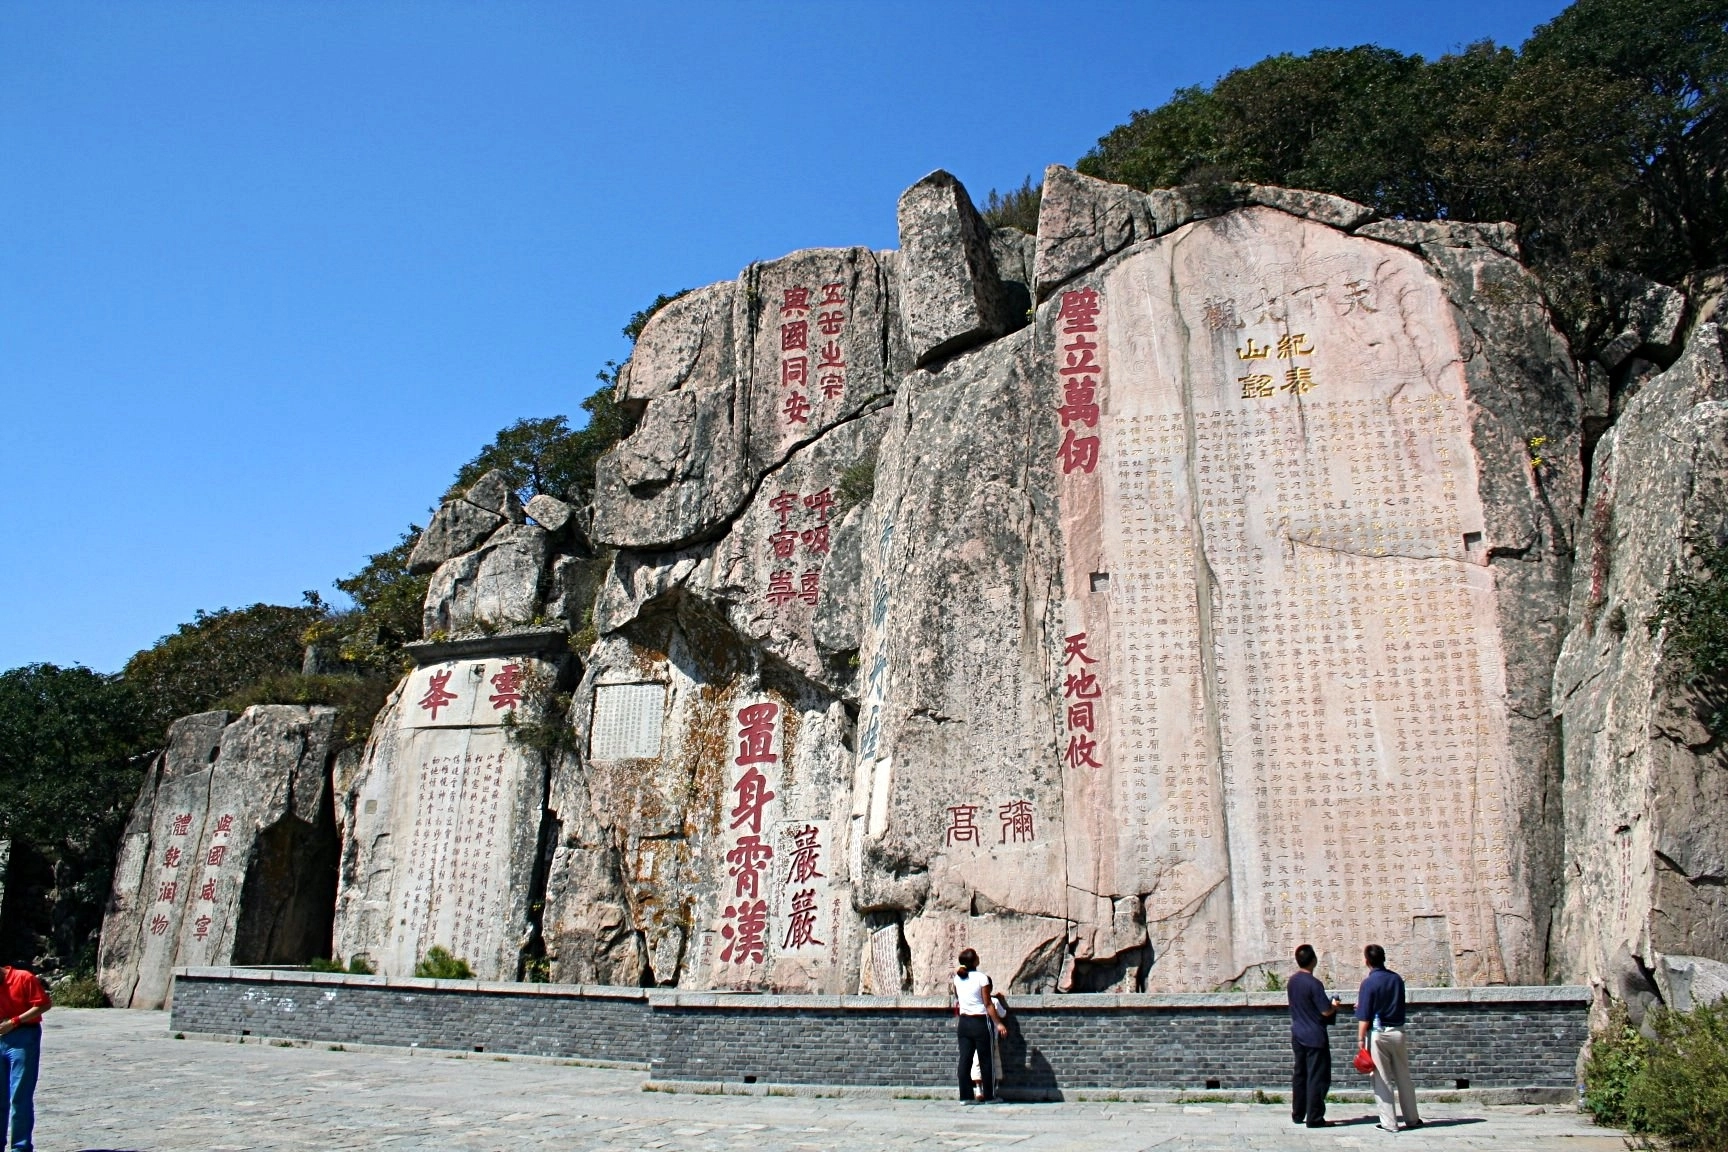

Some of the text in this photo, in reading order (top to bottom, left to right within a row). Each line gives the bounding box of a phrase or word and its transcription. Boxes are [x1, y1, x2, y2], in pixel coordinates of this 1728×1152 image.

[1056, 286, 1101, 475] 壁立萬仞
[720, 702, 779, 965] 置身霄漢
